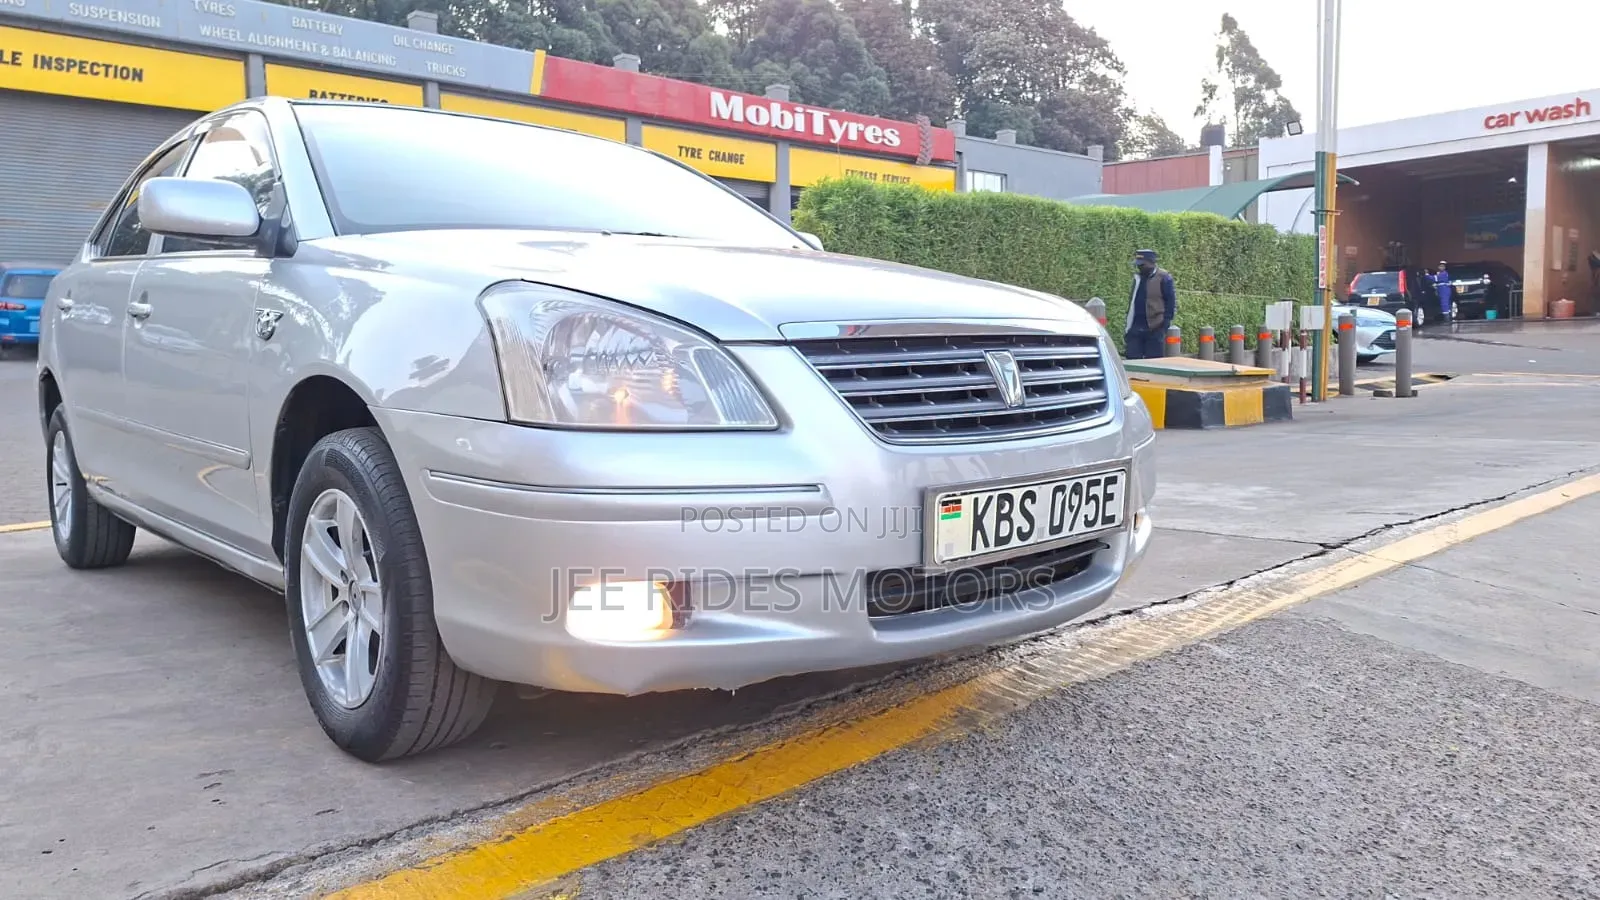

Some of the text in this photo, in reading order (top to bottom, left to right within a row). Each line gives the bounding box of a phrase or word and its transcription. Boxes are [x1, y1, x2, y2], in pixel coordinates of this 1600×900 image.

[69, 2, 161, 28] SUSPENSION
[193, 0, 236, 17] TYRES
[291, 16, 343, 35] BATTERY
[200, 24, 397, 66] WHEEL ALIGNMENT & BALANCING
[393, 34, 456, 55] OIL CHANGE
[33, 53, 144, 82] INSPECTION
[426, 61, 466, 77] TRUCKS
[309, 89, 388, 104] BATTE
[710, 91, 901, 147] MobiTyres
[1484, 97, 1591, 130] car wash
[678, 145, 745, 165] TYRE CHANGE
[971, 475, 1118, 551] KBS 095E
